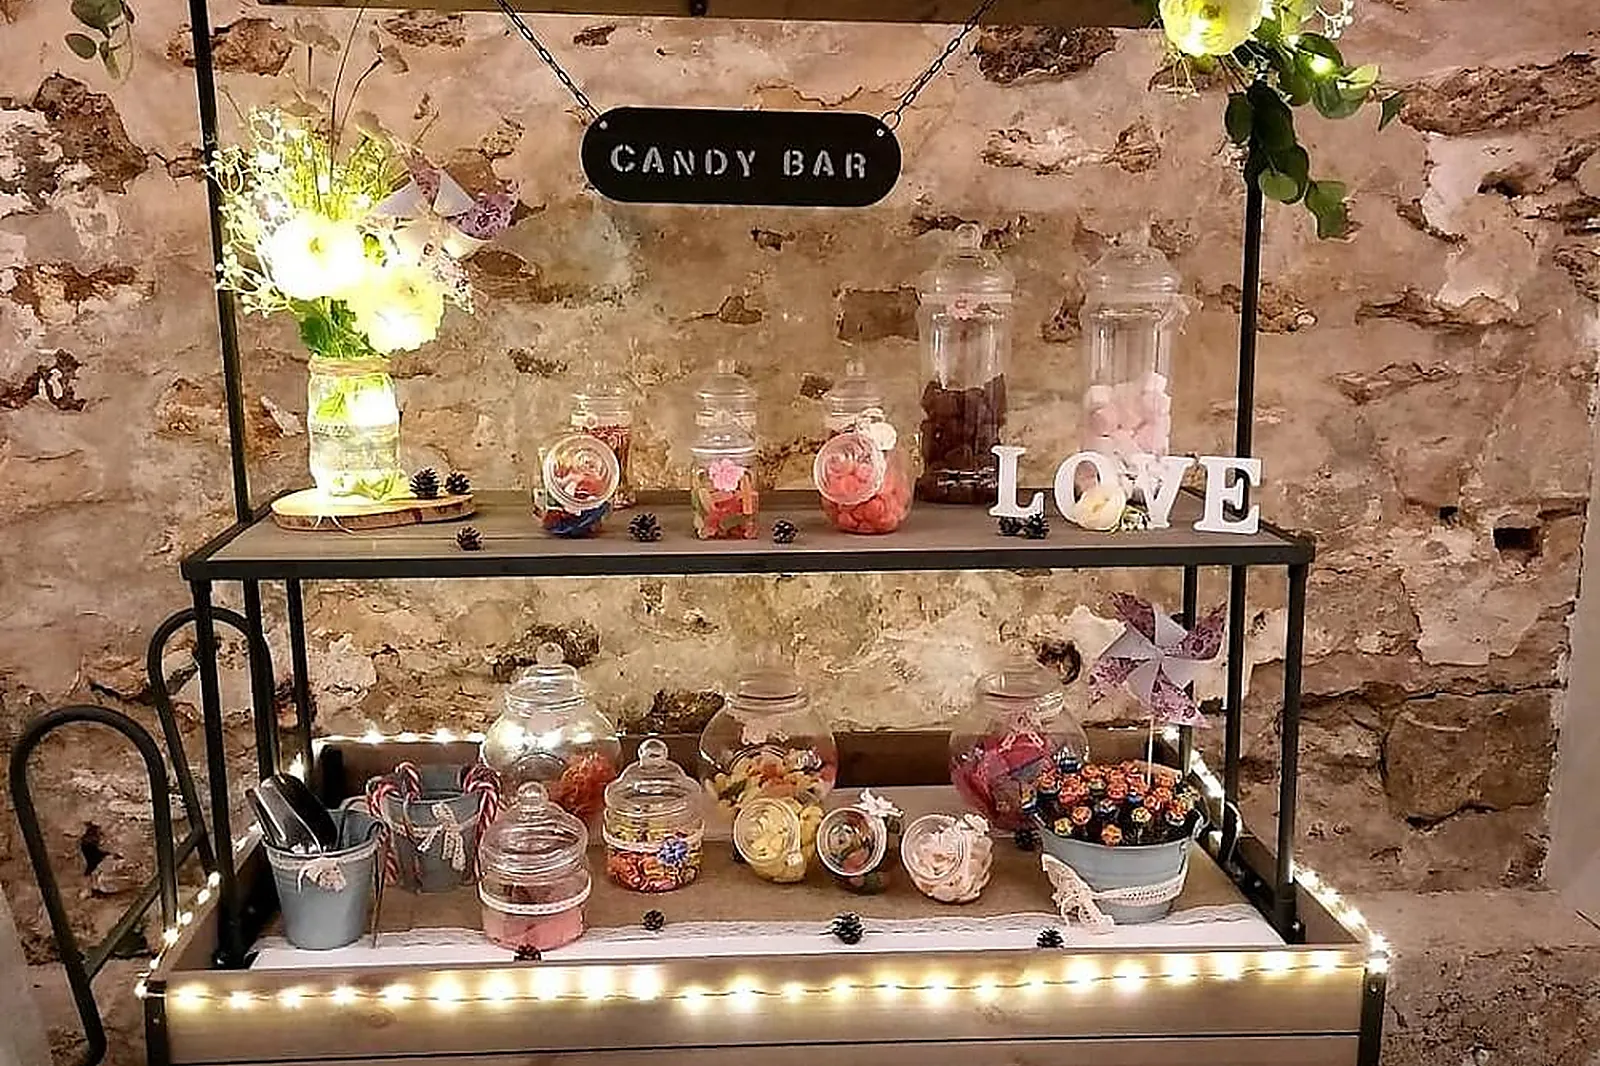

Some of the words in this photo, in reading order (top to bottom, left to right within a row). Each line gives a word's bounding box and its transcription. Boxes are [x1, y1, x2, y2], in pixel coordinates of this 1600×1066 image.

[609, 143, 757, 179] CANDY
[782, 149, 868, 180] BAR
[988, 445, 1263, 535] LOVE
